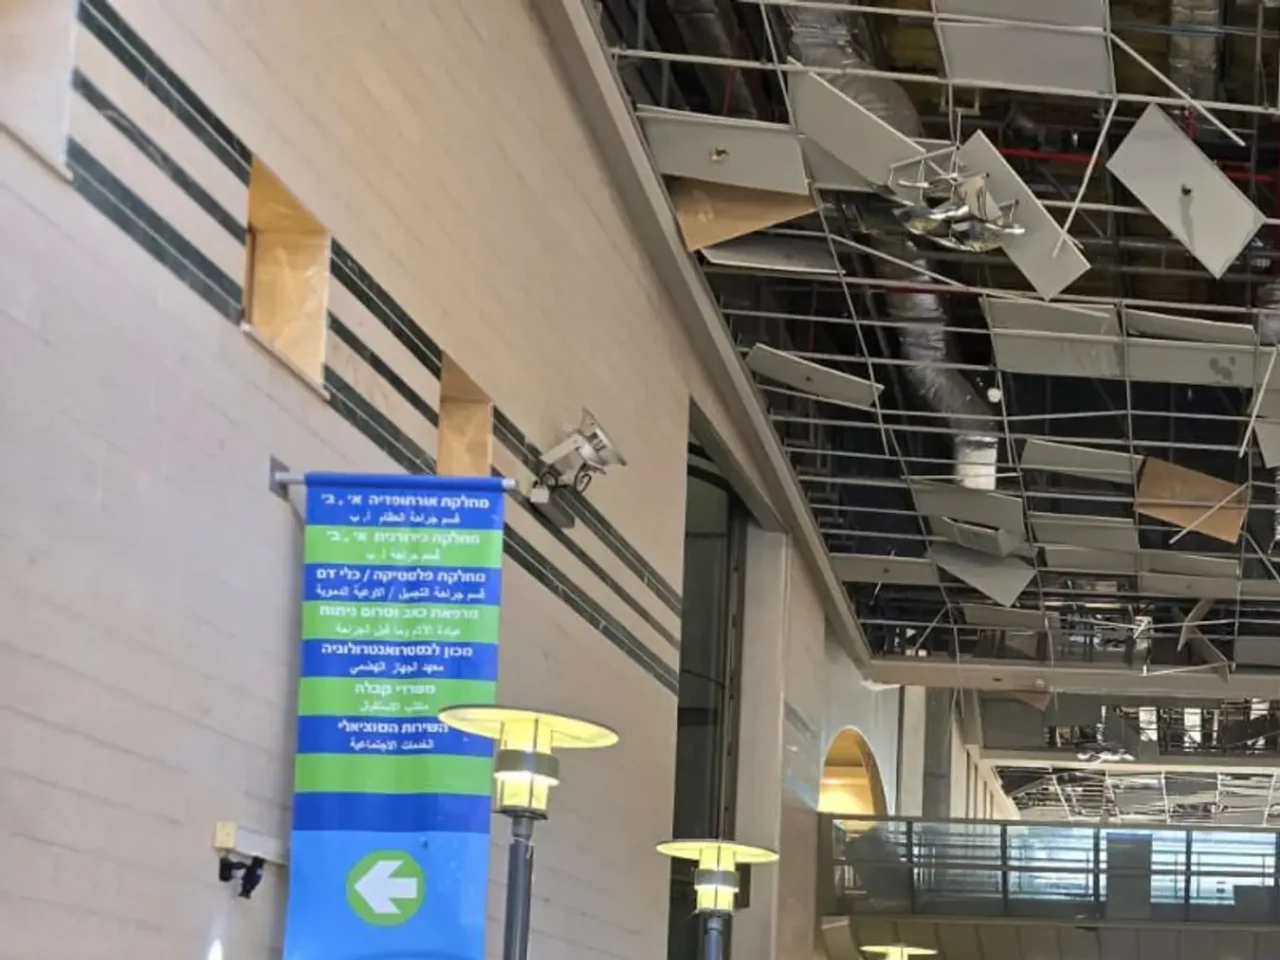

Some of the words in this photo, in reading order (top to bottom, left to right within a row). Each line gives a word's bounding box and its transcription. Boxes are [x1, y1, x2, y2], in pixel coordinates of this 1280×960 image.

[368, 494, 438, 508] אורתופדיה
[316, 568, 336, 580] דם
[339, 566, 361, 580] כלי
[373, 567, 434, 583] פלסטיקה
[319, 605, 357, 617] ניתוח
[402, 607, 429, 618] כאב
[430, 608, 479, 619] מרפאת
[444, 645, 473, 658] מכון
[354, 681, 392, 697] קבלה
[337, 718, 398, 733] הסוציאלי
[401, 721, 449, 734] השירות
